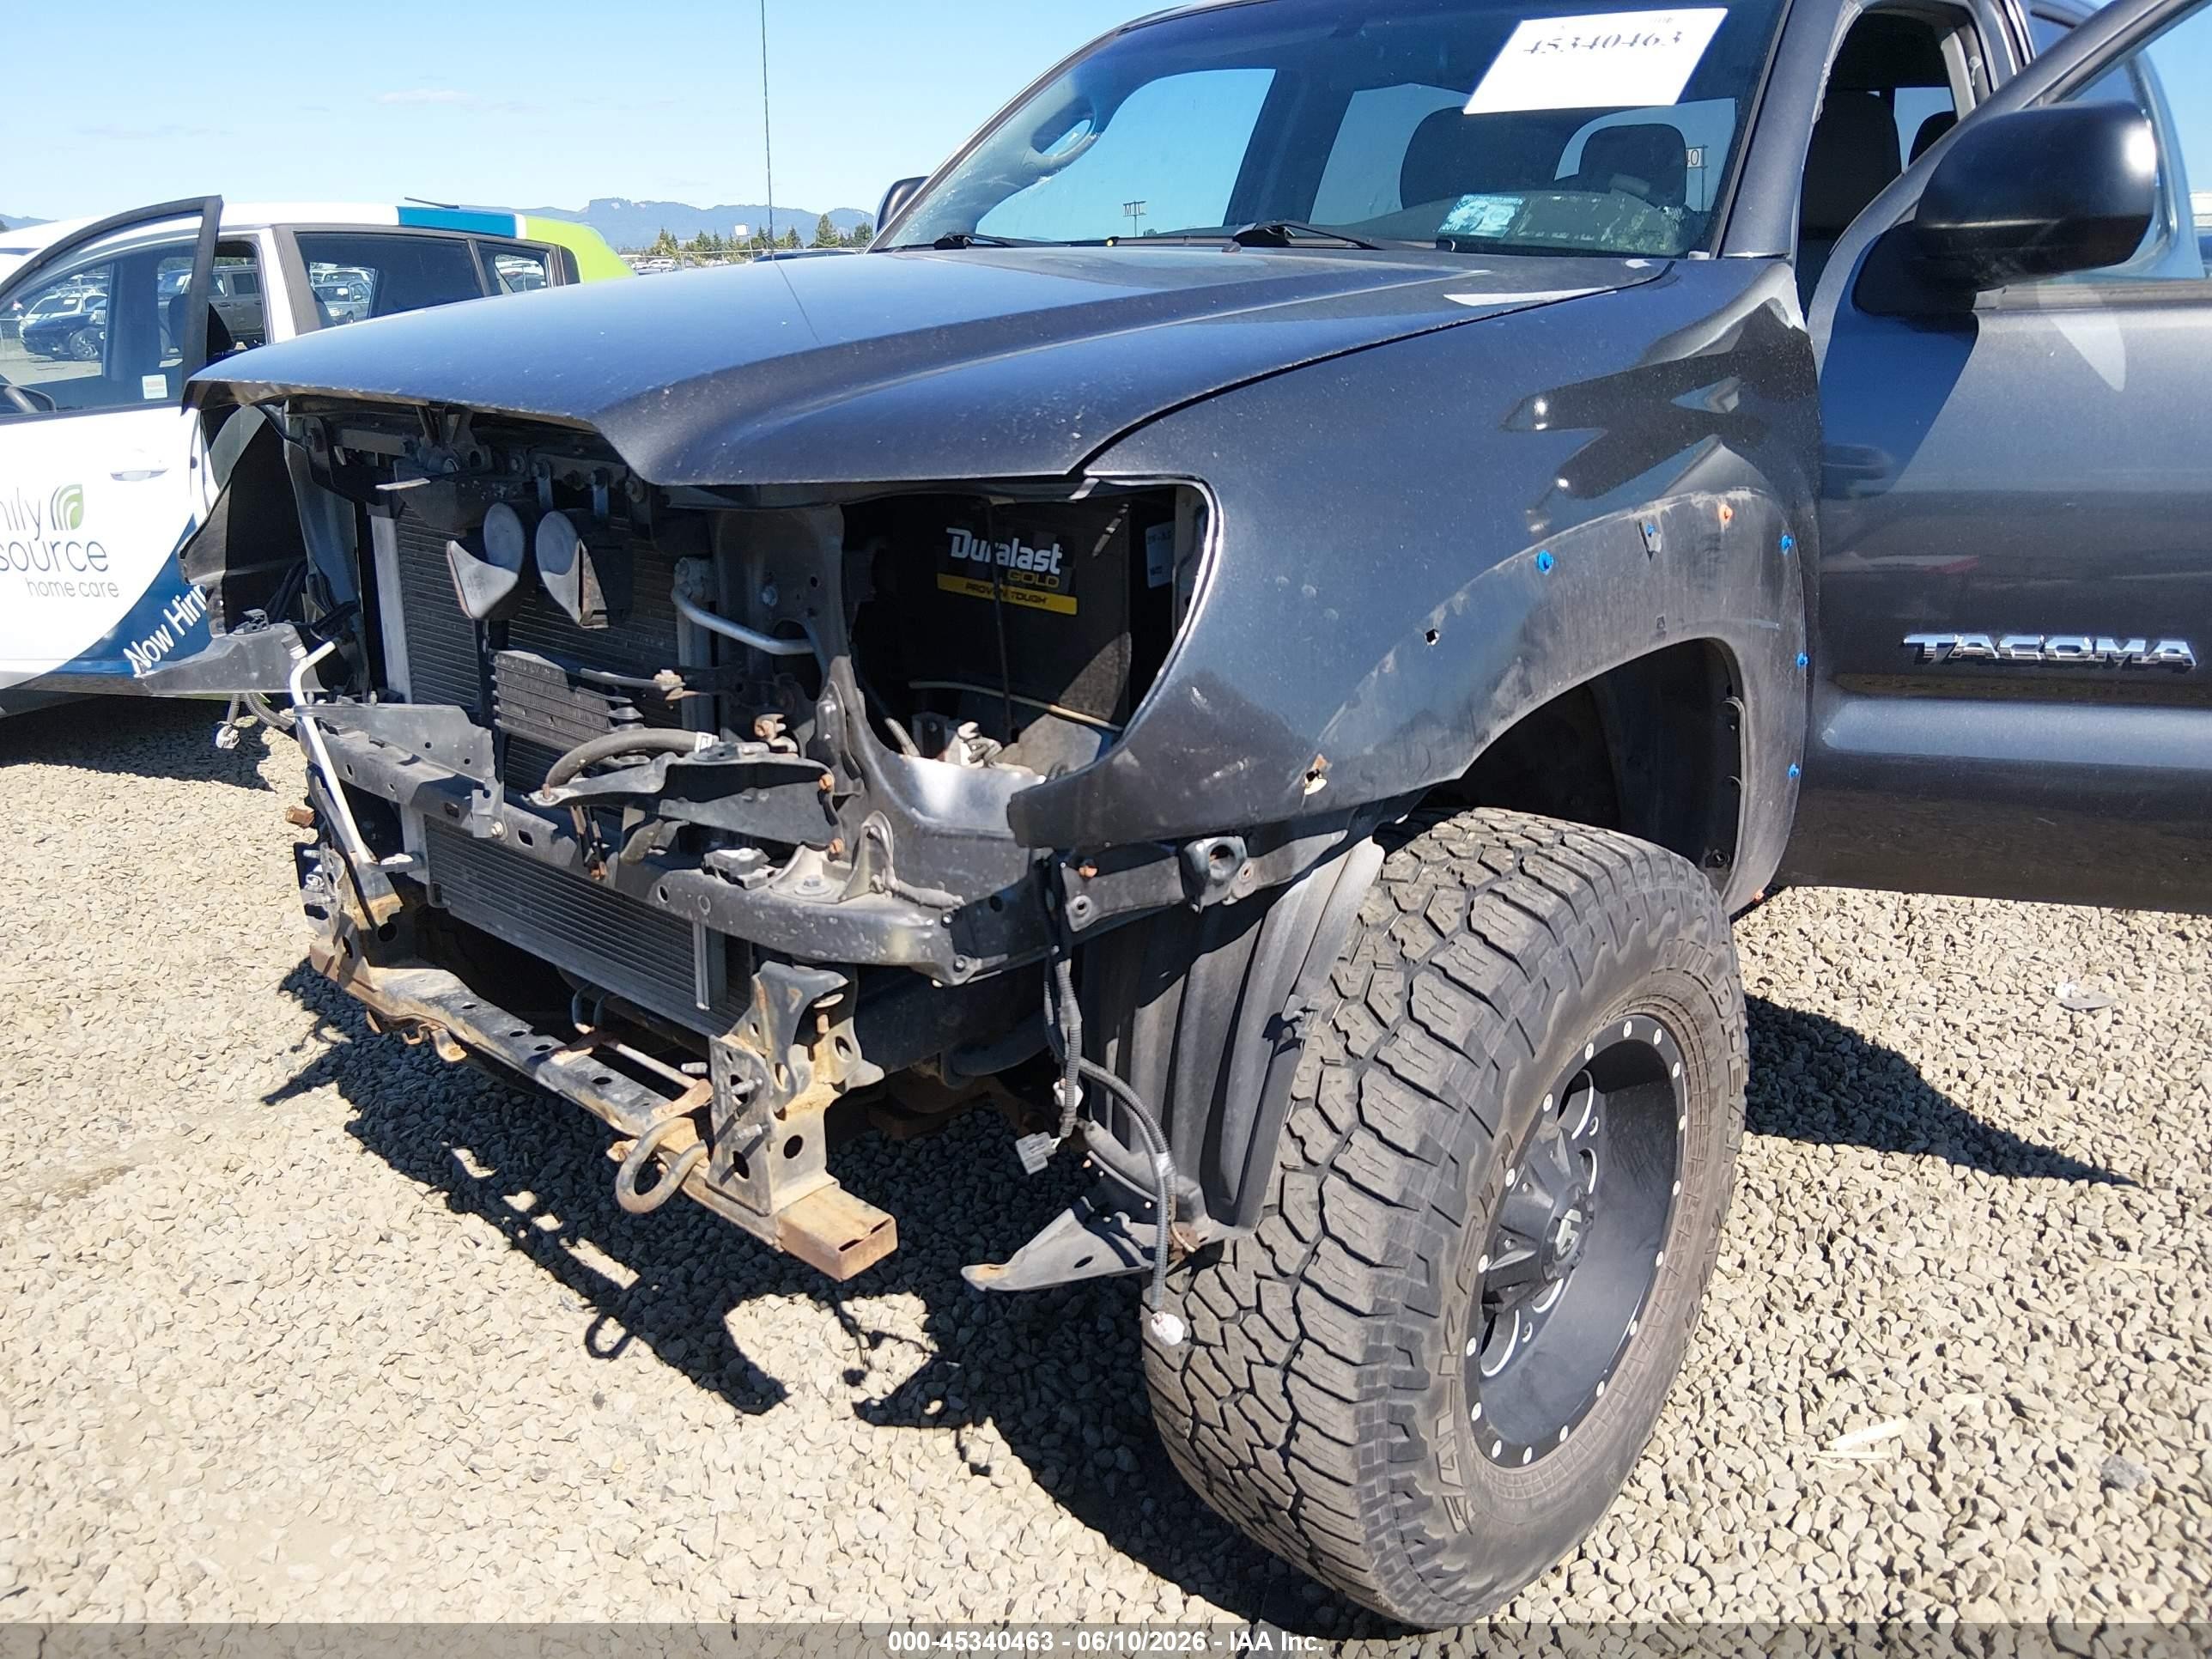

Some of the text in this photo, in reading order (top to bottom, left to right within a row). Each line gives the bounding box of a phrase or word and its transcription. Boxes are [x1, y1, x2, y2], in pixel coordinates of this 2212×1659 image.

[25, 577, 119, 598] home care
[1007, 568, 1060, 588] GOLD
[965, 581, 1008, 598] PROVN
[123, 623, 174, 676] Now
[1903, 633, 2197, 670] TACOMA
